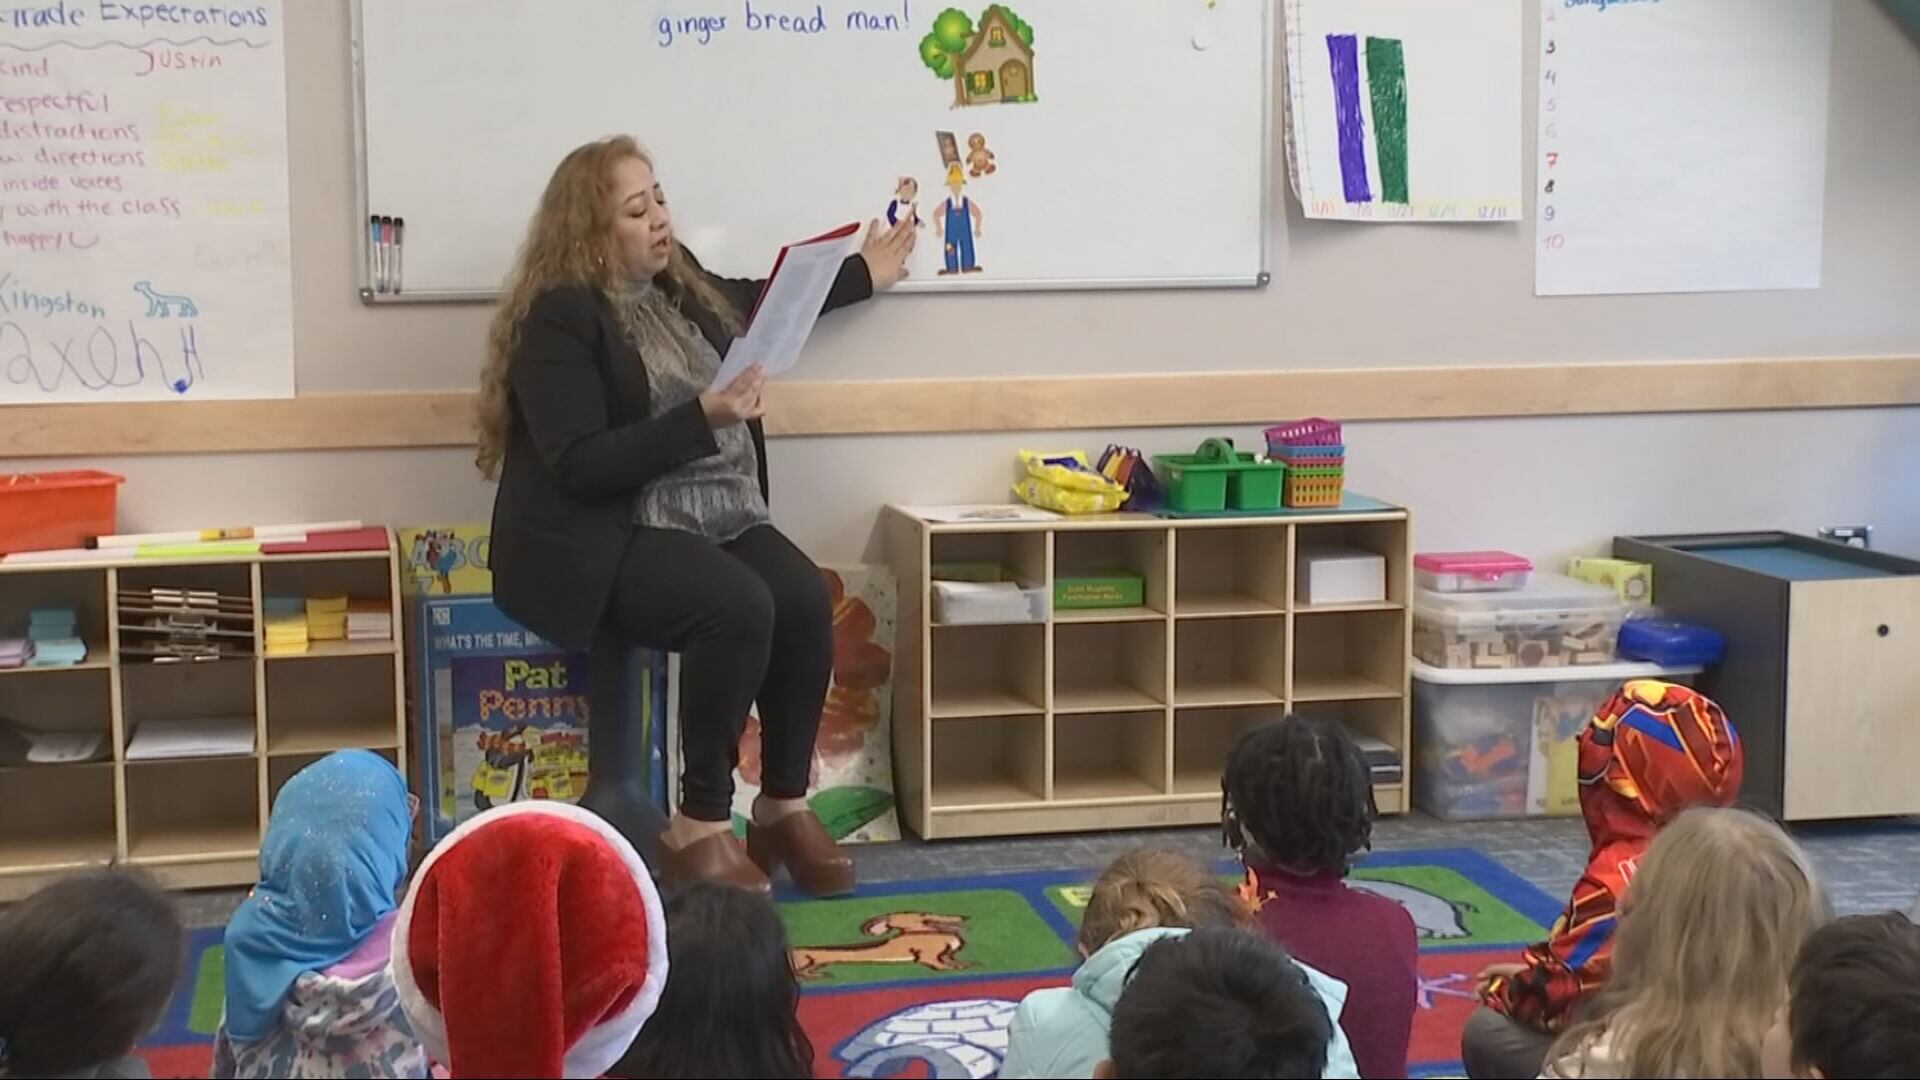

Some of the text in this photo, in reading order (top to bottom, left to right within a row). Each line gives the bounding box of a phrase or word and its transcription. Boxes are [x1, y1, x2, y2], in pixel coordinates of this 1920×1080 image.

[99, 1, 268, 29] Expectations
[659, 0, 909, 48] ginger bread man!
[1546, 40, 1555, 54] 3
[1546, 69, 1556, 85] 4
[34, 146, 145, 167] directions
[1546, 152, 1558, 168] 7
[16, 198, 70, 217] with
[78, 199, 111, 216] the
[122, 196, 182, 220] class
[1544, 205, 1555, 221] 9
[3, 230, 62, 251] happy
[1543, 234, 1565, 249] 10
[474, 632, 494, 648] THE
[504, 659, 568, 691] Pat
[479, 690, 590, 725] Penny
